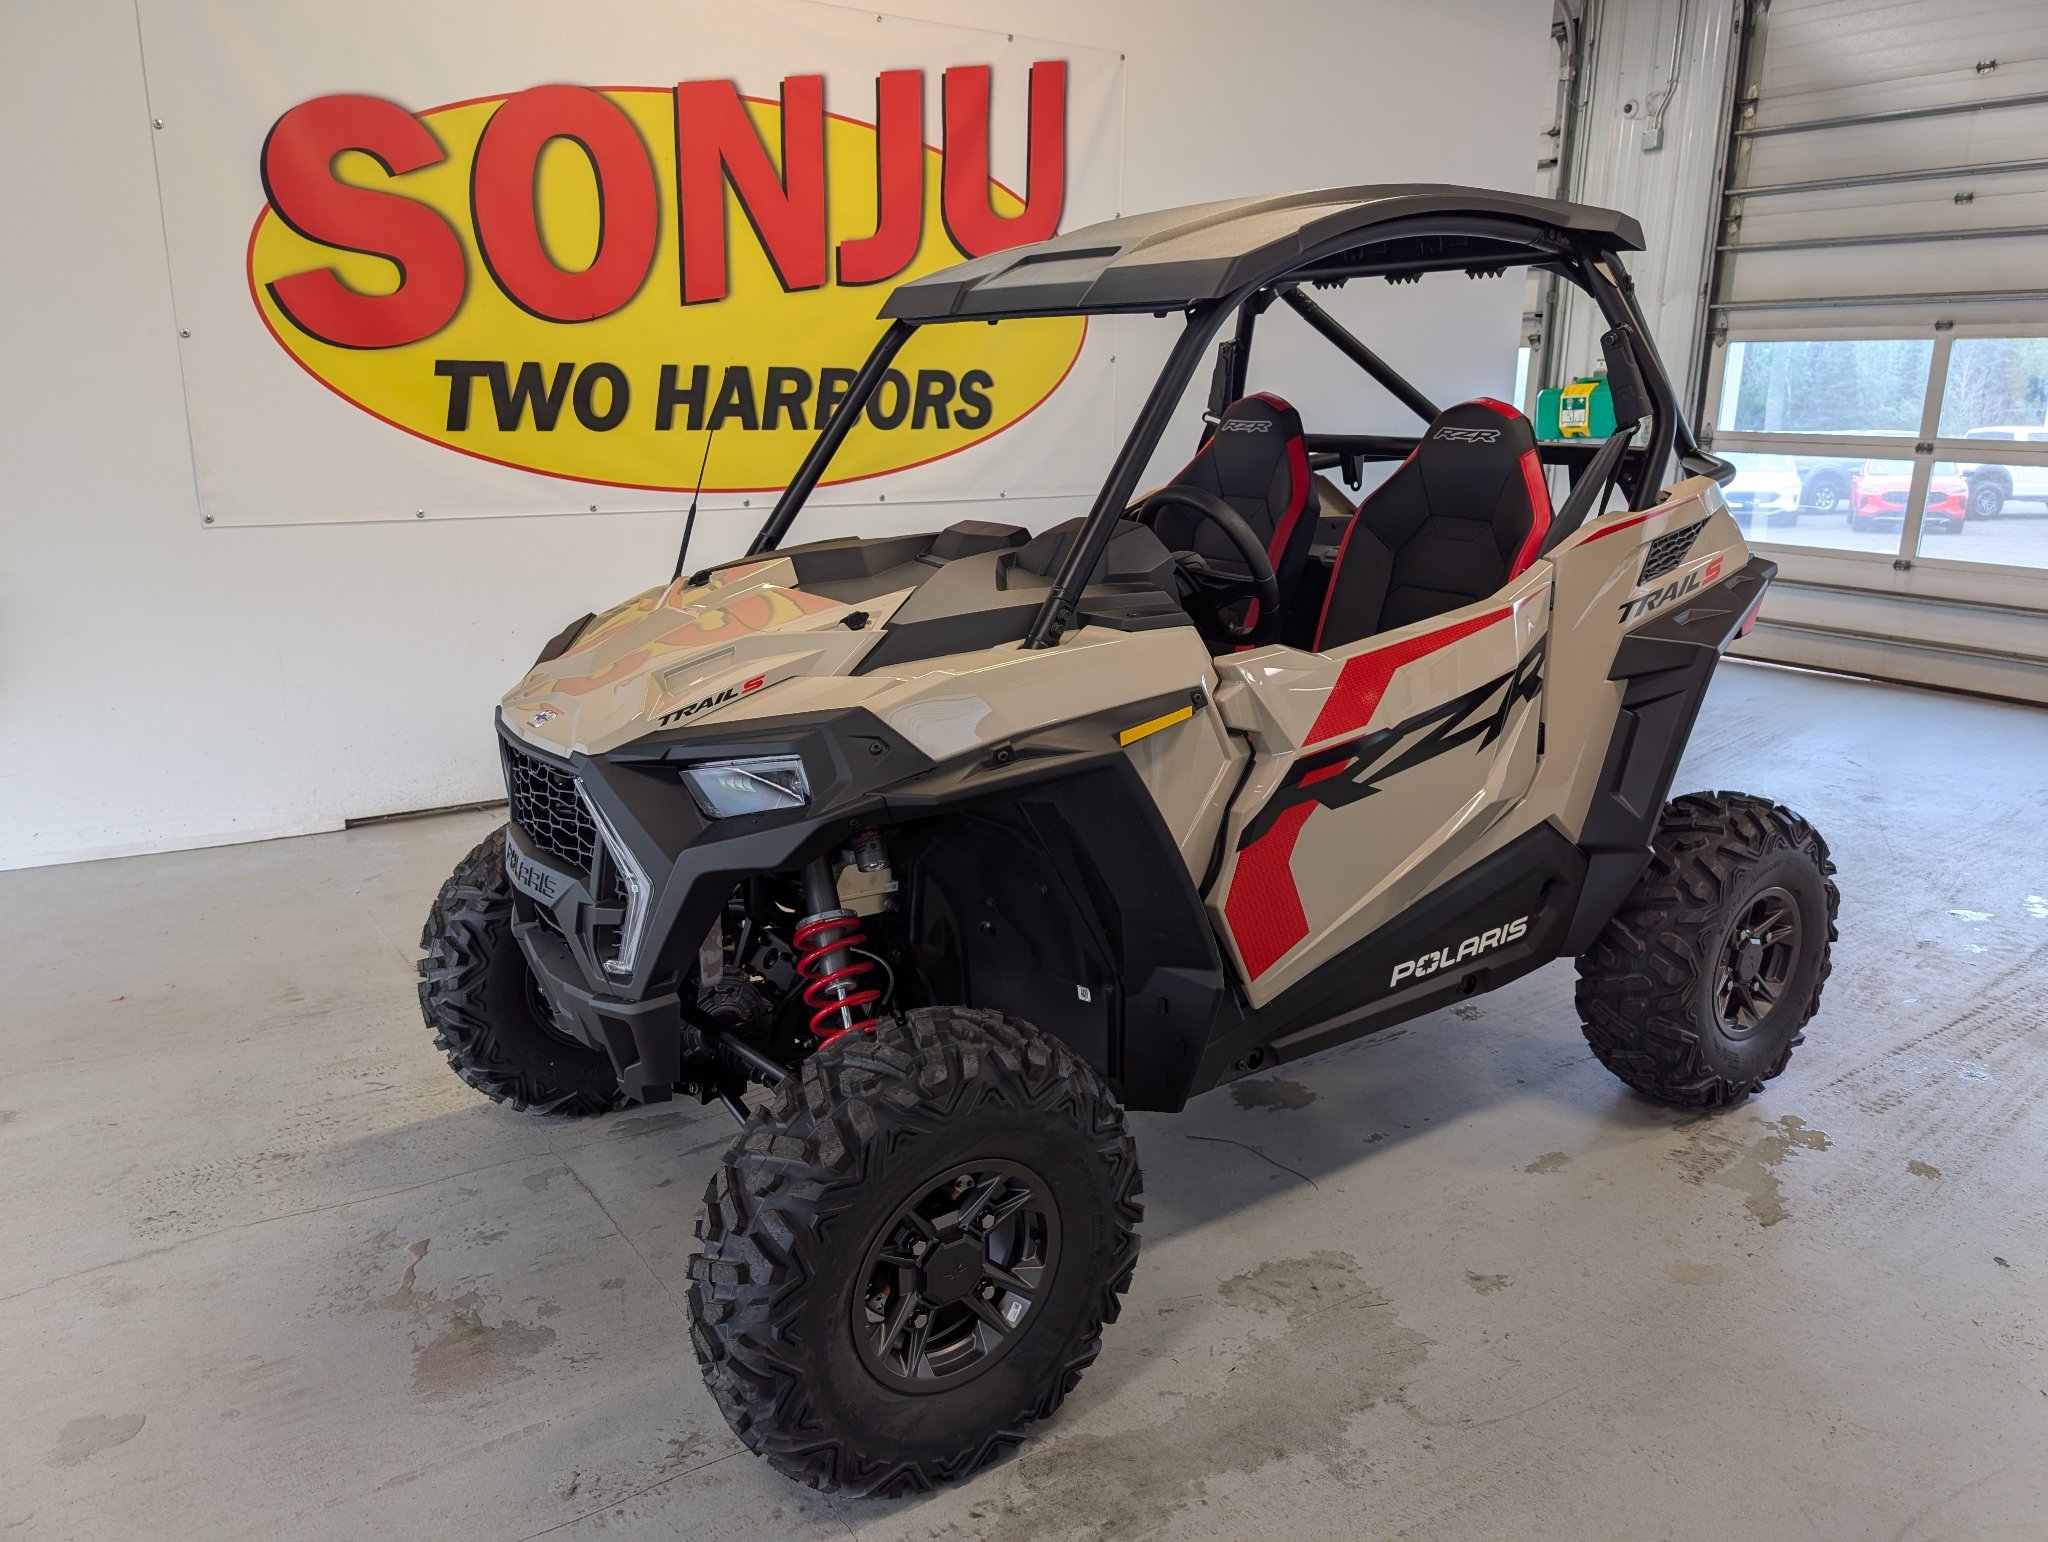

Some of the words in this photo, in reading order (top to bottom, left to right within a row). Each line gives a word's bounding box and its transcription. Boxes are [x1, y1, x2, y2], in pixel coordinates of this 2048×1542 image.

[260, 60, 1067, 350] SONJU
[433, 359, 630, 433] TWO
[1221, 419, 1272, 433] RZR
[1433, 426, 1501, 443] RZR
[1236, 632, 1547, 853] RZR
[506, 842, 557, 899] POLARIS
[1389, 915, 1529, 988] POLARIS
